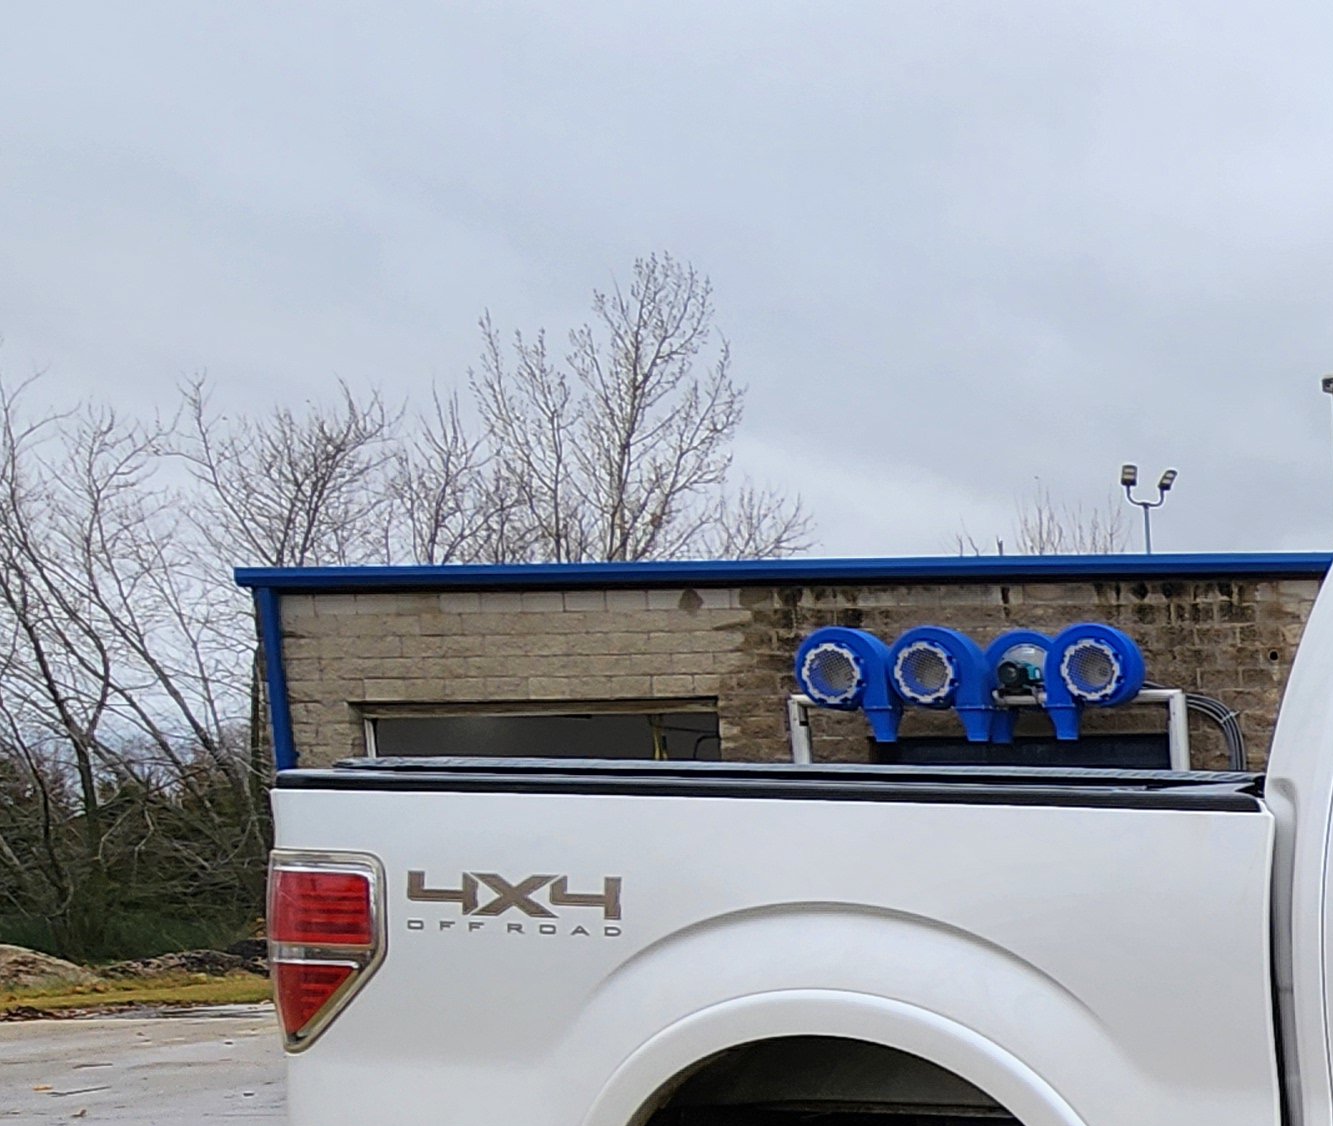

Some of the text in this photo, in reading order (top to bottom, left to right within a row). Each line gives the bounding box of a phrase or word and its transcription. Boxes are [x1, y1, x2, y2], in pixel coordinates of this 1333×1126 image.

[407, 870, 622, 921] 4X4
[407, 919, 622, 937] OFF ROAD
